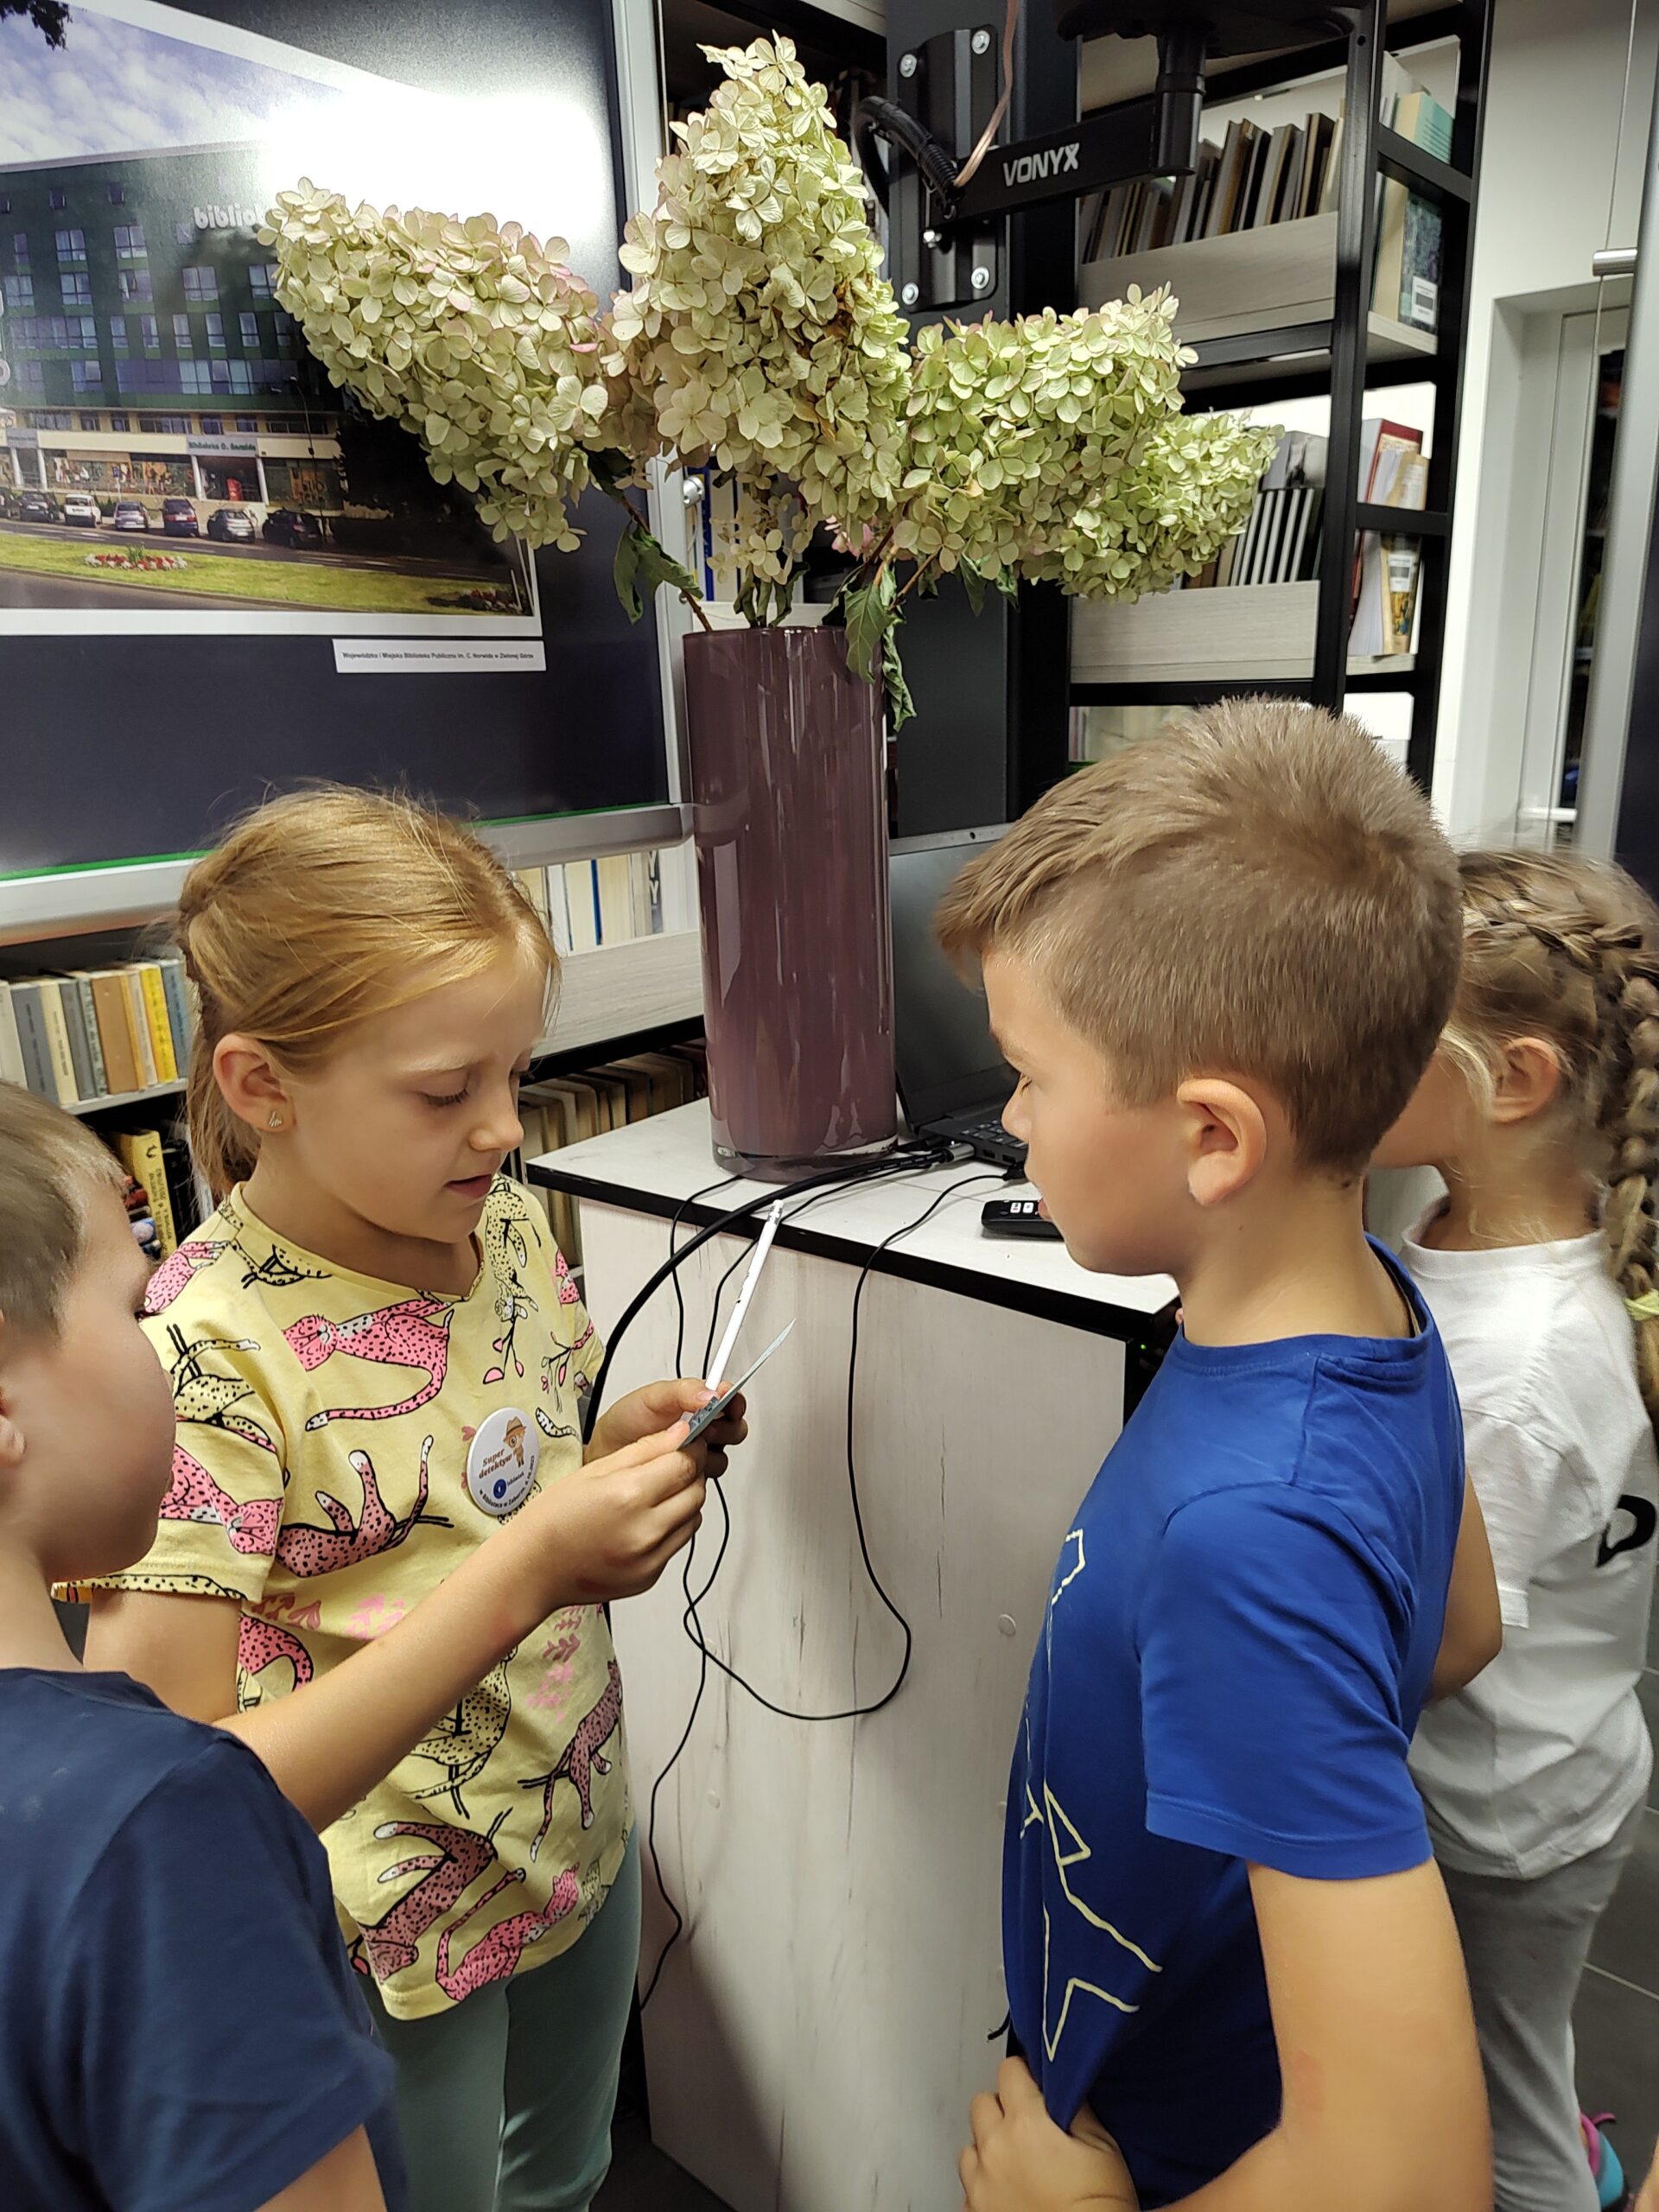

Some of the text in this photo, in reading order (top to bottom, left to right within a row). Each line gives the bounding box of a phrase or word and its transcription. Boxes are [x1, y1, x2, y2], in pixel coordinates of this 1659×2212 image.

[1003, 143, 1079, 187] VONYX
[479, 1453, 512, 1479] detektyw
[482, 1448, 505, 1466] Super
